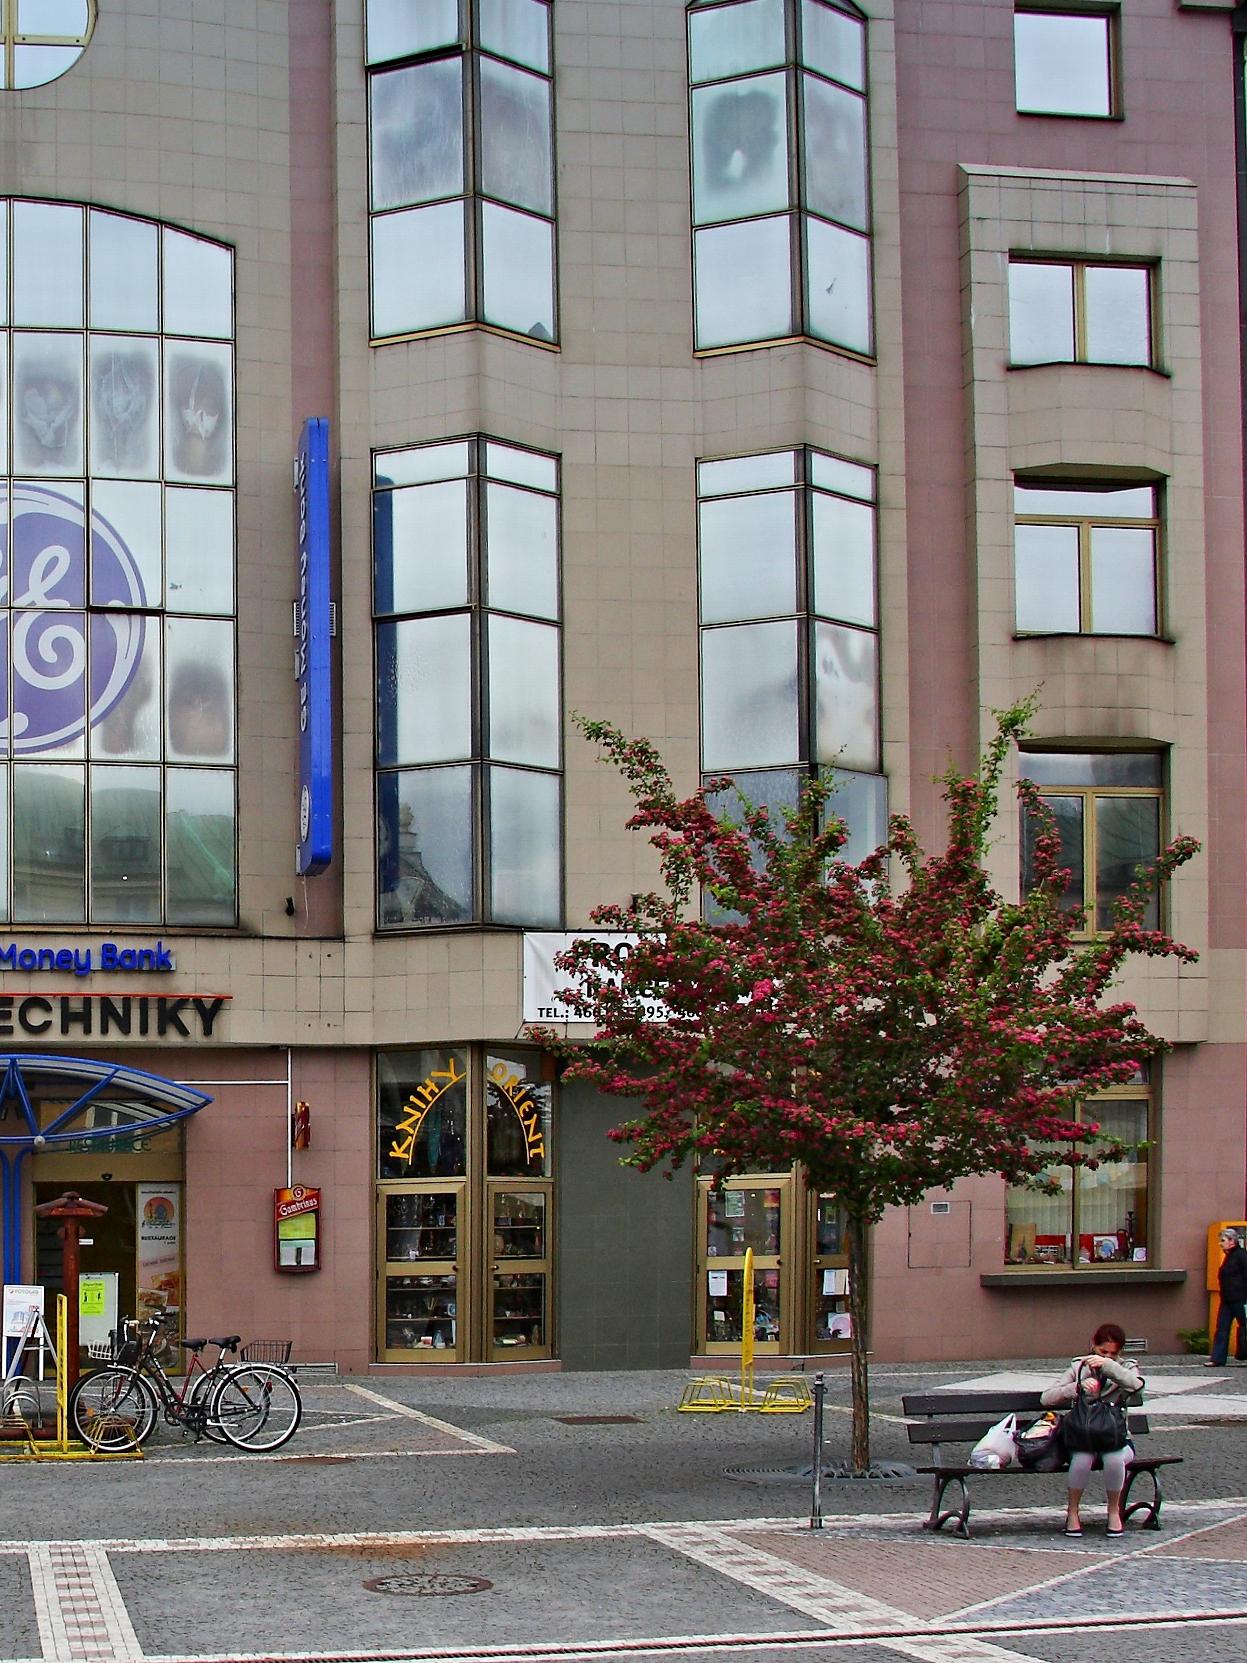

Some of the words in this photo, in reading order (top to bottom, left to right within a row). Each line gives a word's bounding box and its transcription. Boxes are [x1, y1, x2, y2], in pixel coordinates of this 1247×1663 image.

[100, 941, 174, 971] Bank
[537, 1007, 570, 1018] TEL.:
[388, 1057, 459, 1160] KNIHY
[490, 1062, 545, 1158] ORIENT
[280, 1197, 318, 1216] Gambrinus
